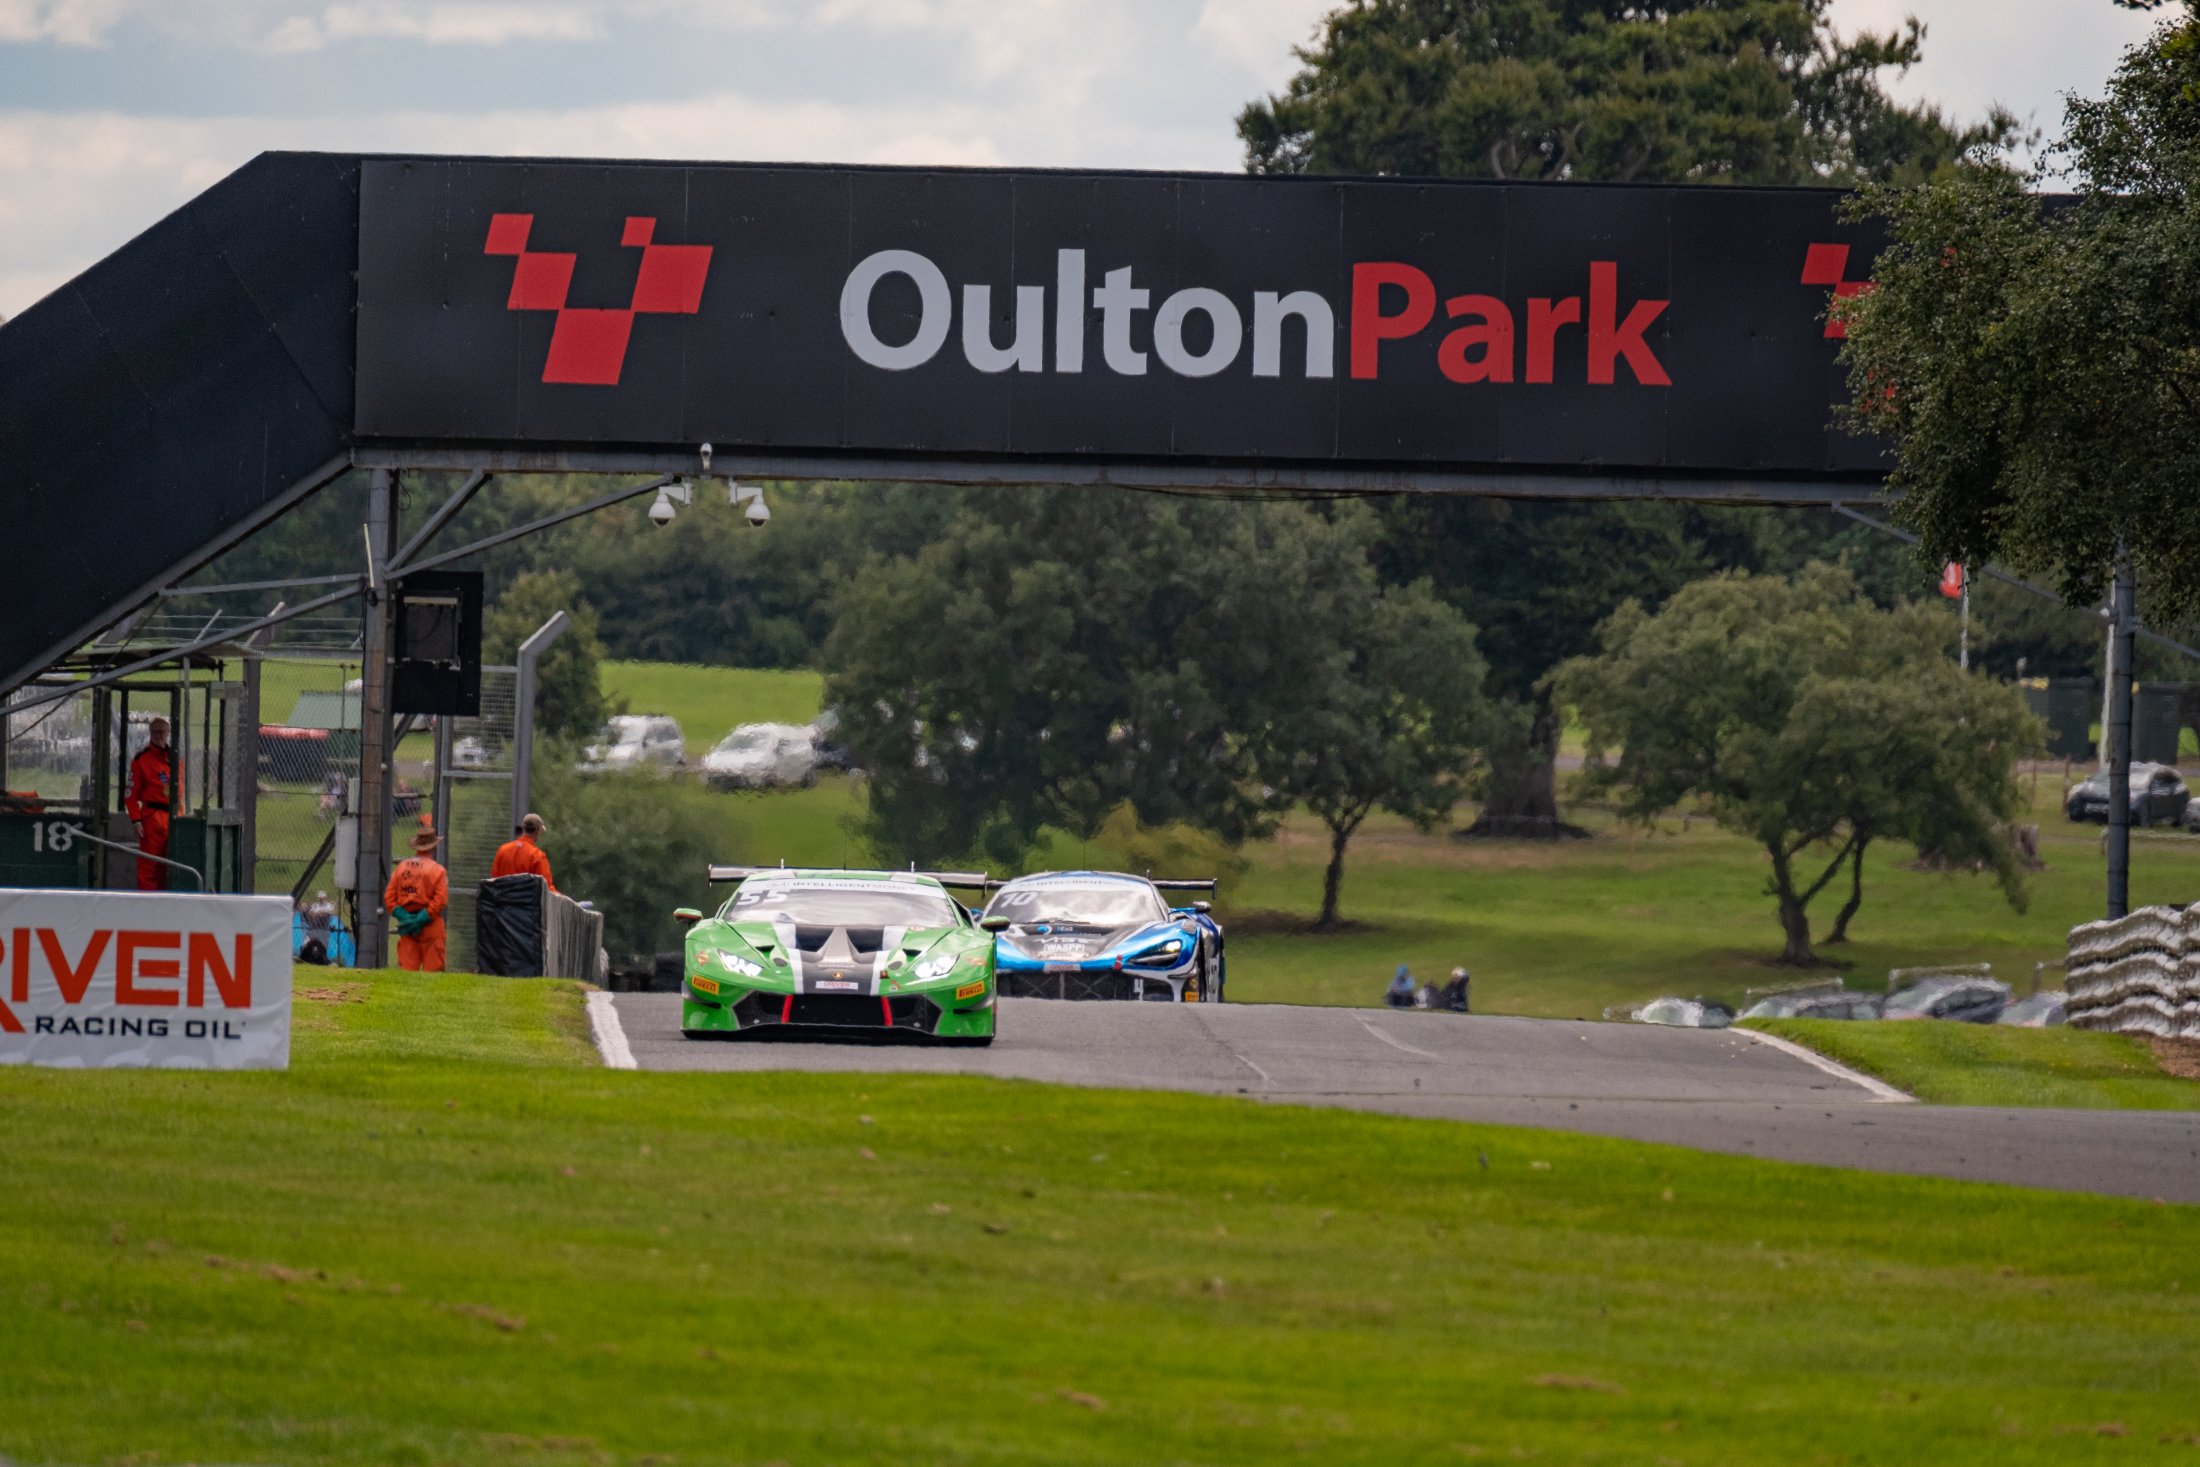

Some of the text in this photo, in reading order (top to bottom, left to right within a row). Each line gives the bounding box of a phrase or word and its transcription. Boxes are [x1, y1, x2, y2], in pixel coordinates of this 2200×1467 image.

[32, 821, 73, 852] 18
[736, 889, 793, 906] 55
[35, 1016, 242, 1040] RACING OIL
